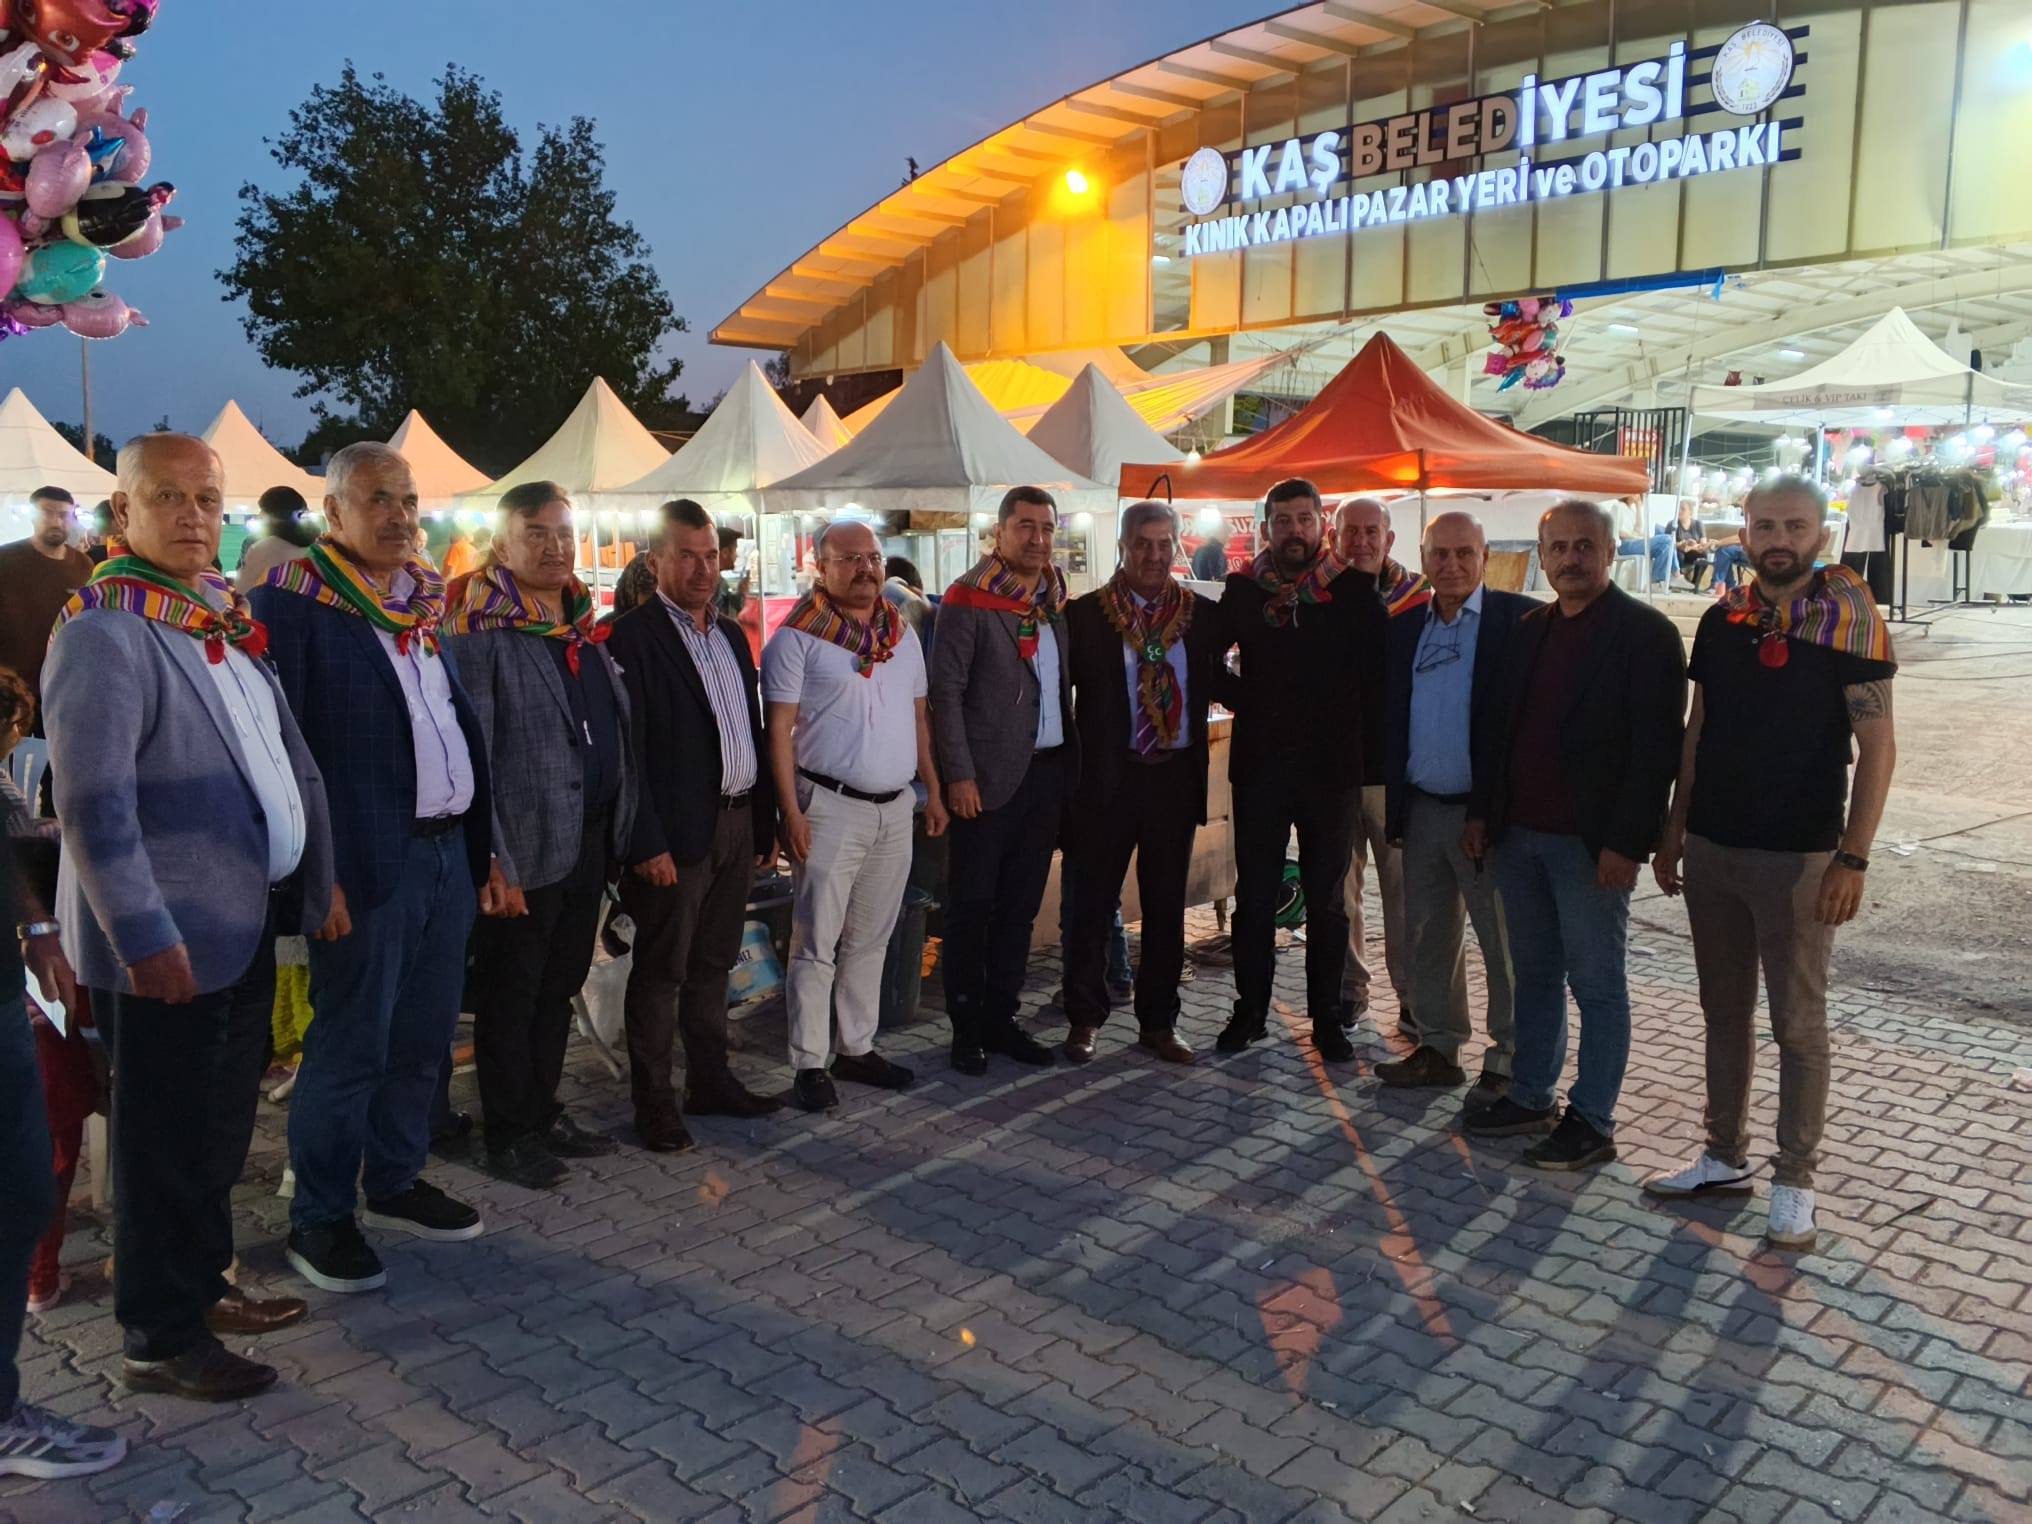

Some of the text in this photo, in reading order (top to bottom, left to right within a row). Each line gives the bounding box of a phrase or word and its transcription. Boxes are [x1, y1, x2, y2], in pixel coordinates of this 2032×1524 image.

[1185, 121, 1780, 256] KINIK KAPALI PAZAR YERİ ve OTOPARKI
[1242, 41, 1685, 199] KAŞ BELEDİYESİ
